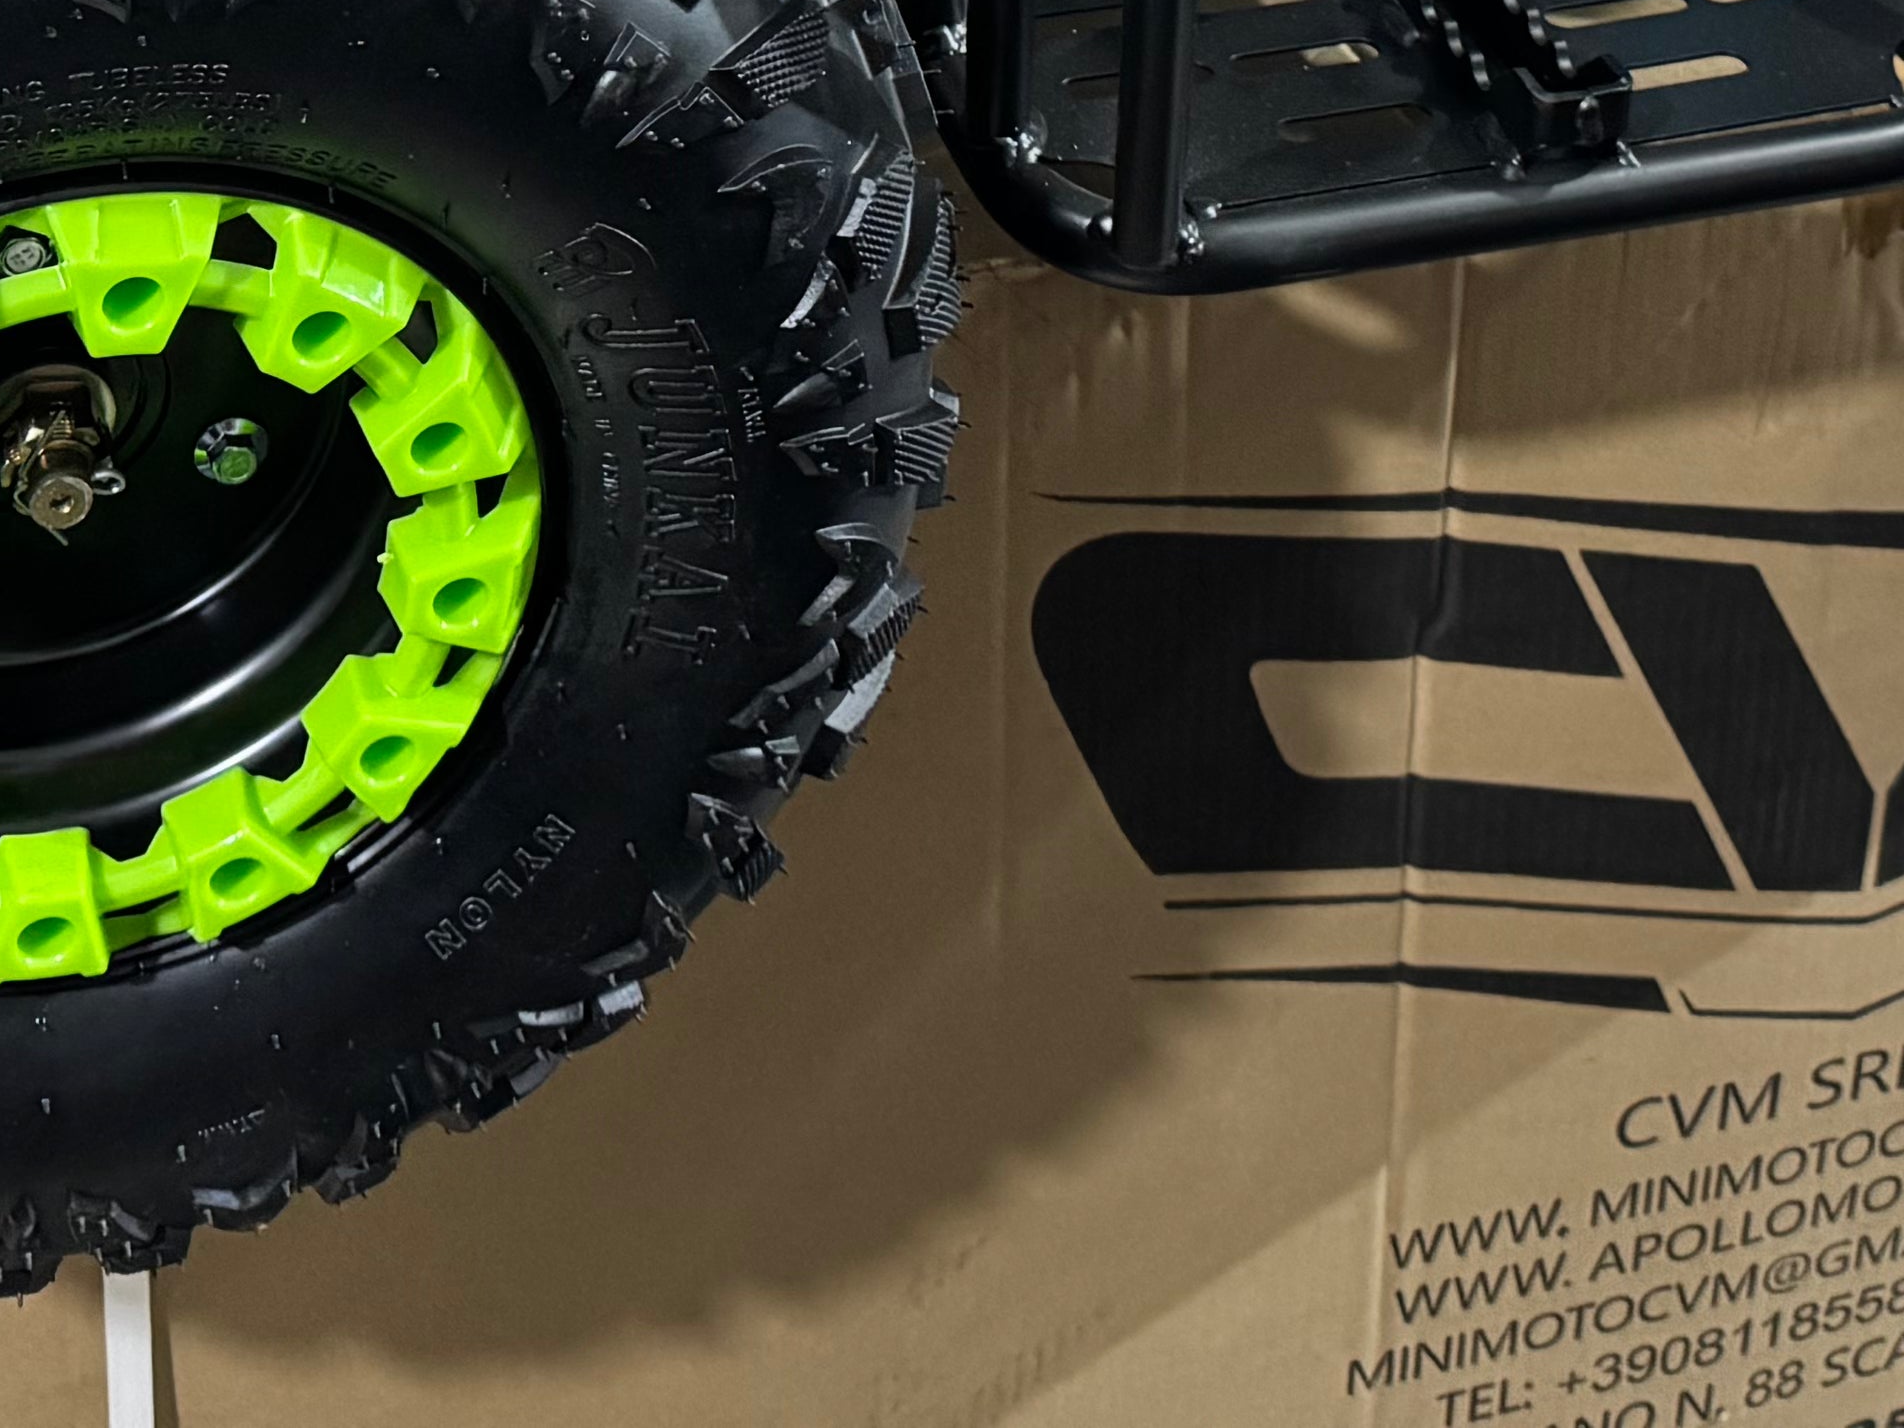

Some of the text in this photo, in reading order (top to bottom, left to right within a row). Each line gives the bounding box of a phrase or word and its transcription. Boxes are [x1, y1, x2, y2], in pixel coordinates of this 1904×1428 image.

[67, 62, 231, 92] TUBELESS
[423, 812, 577, 962] NYLON
[1616, 1072, 1783, 1149] CVM
[1389, 1197, 1571, 1270] WWW.
[1395, 1252, 1574, 1325] WWW.
[1436, 1380, 1534, 1428] TEL:
[1745, 1360, 1804, 1410] 88
